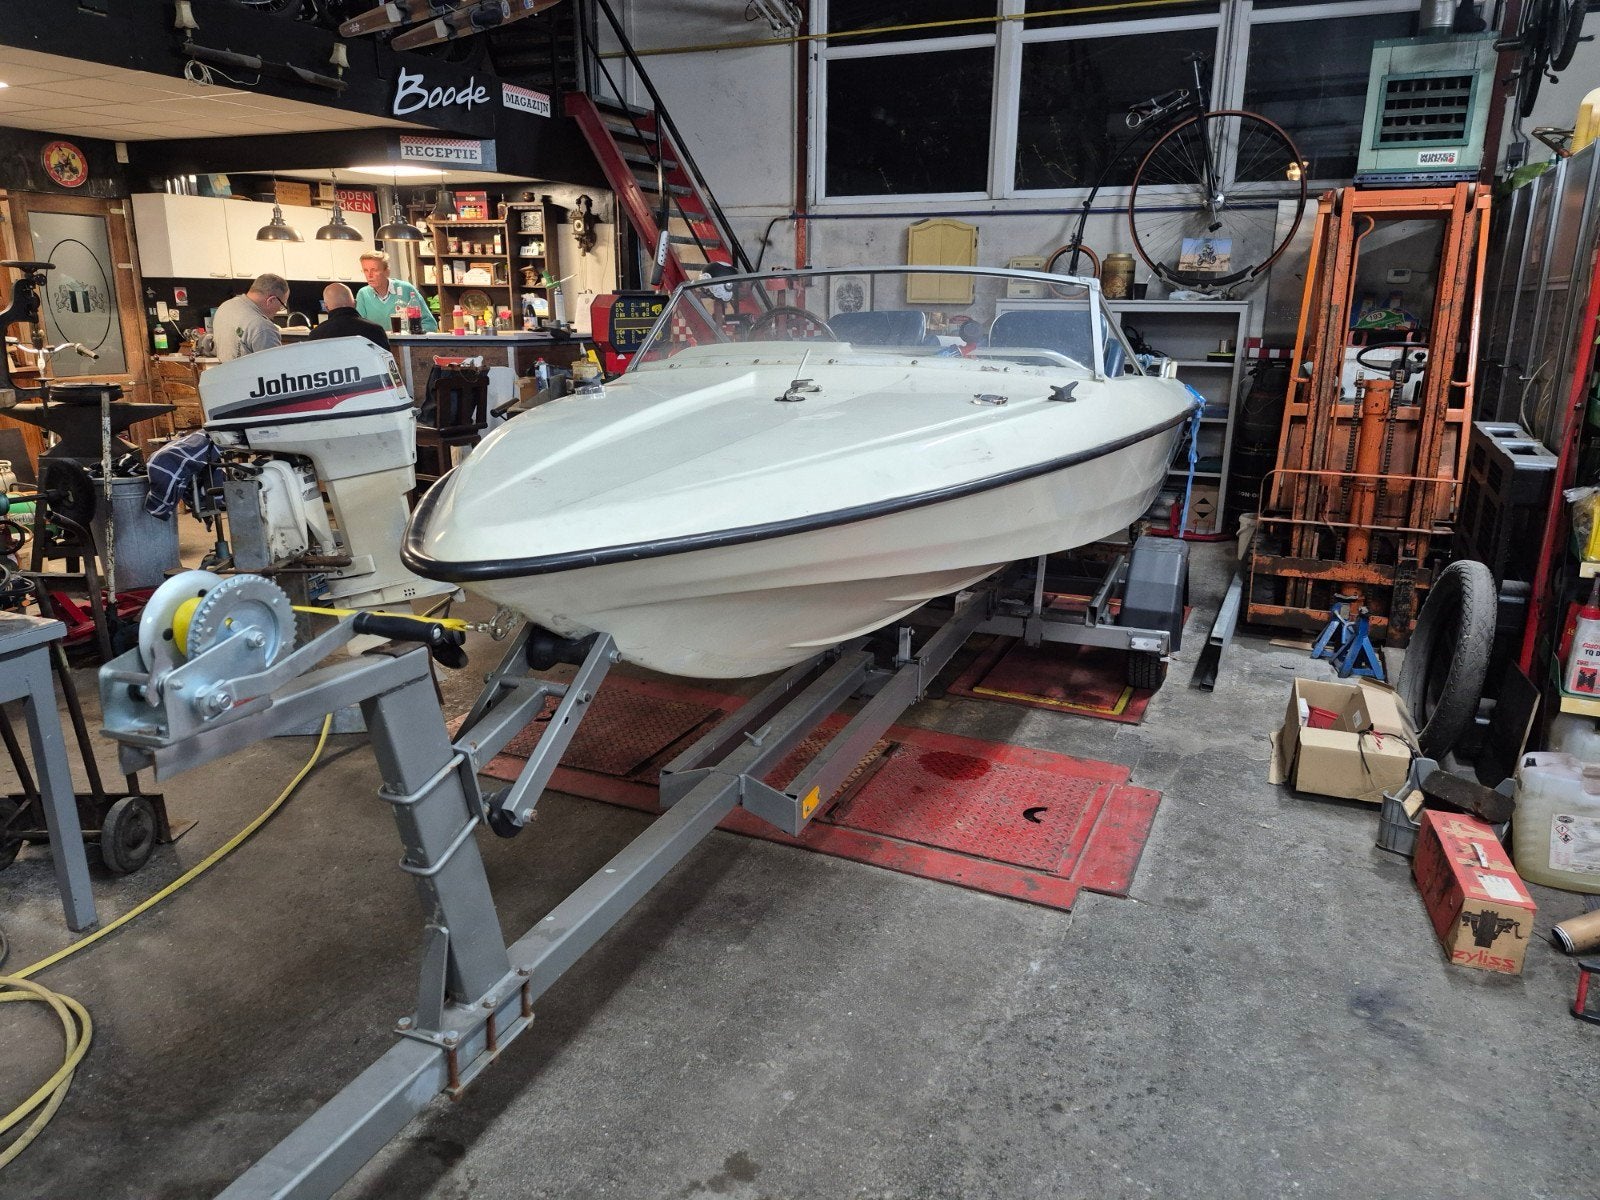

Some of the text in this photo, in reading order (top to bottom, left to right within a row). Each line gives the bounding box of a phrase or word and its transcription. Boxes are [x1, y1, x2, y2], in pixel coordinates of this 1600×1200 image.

[393, 66, 490, 116] Boode
[505, 92, 549, 114] MAGAZIJN
[404, 145, 478, 160] RECEPTIE
[250, 366, 361, 399] Johnson
[1452, 949, 1516, 968] zyliss
